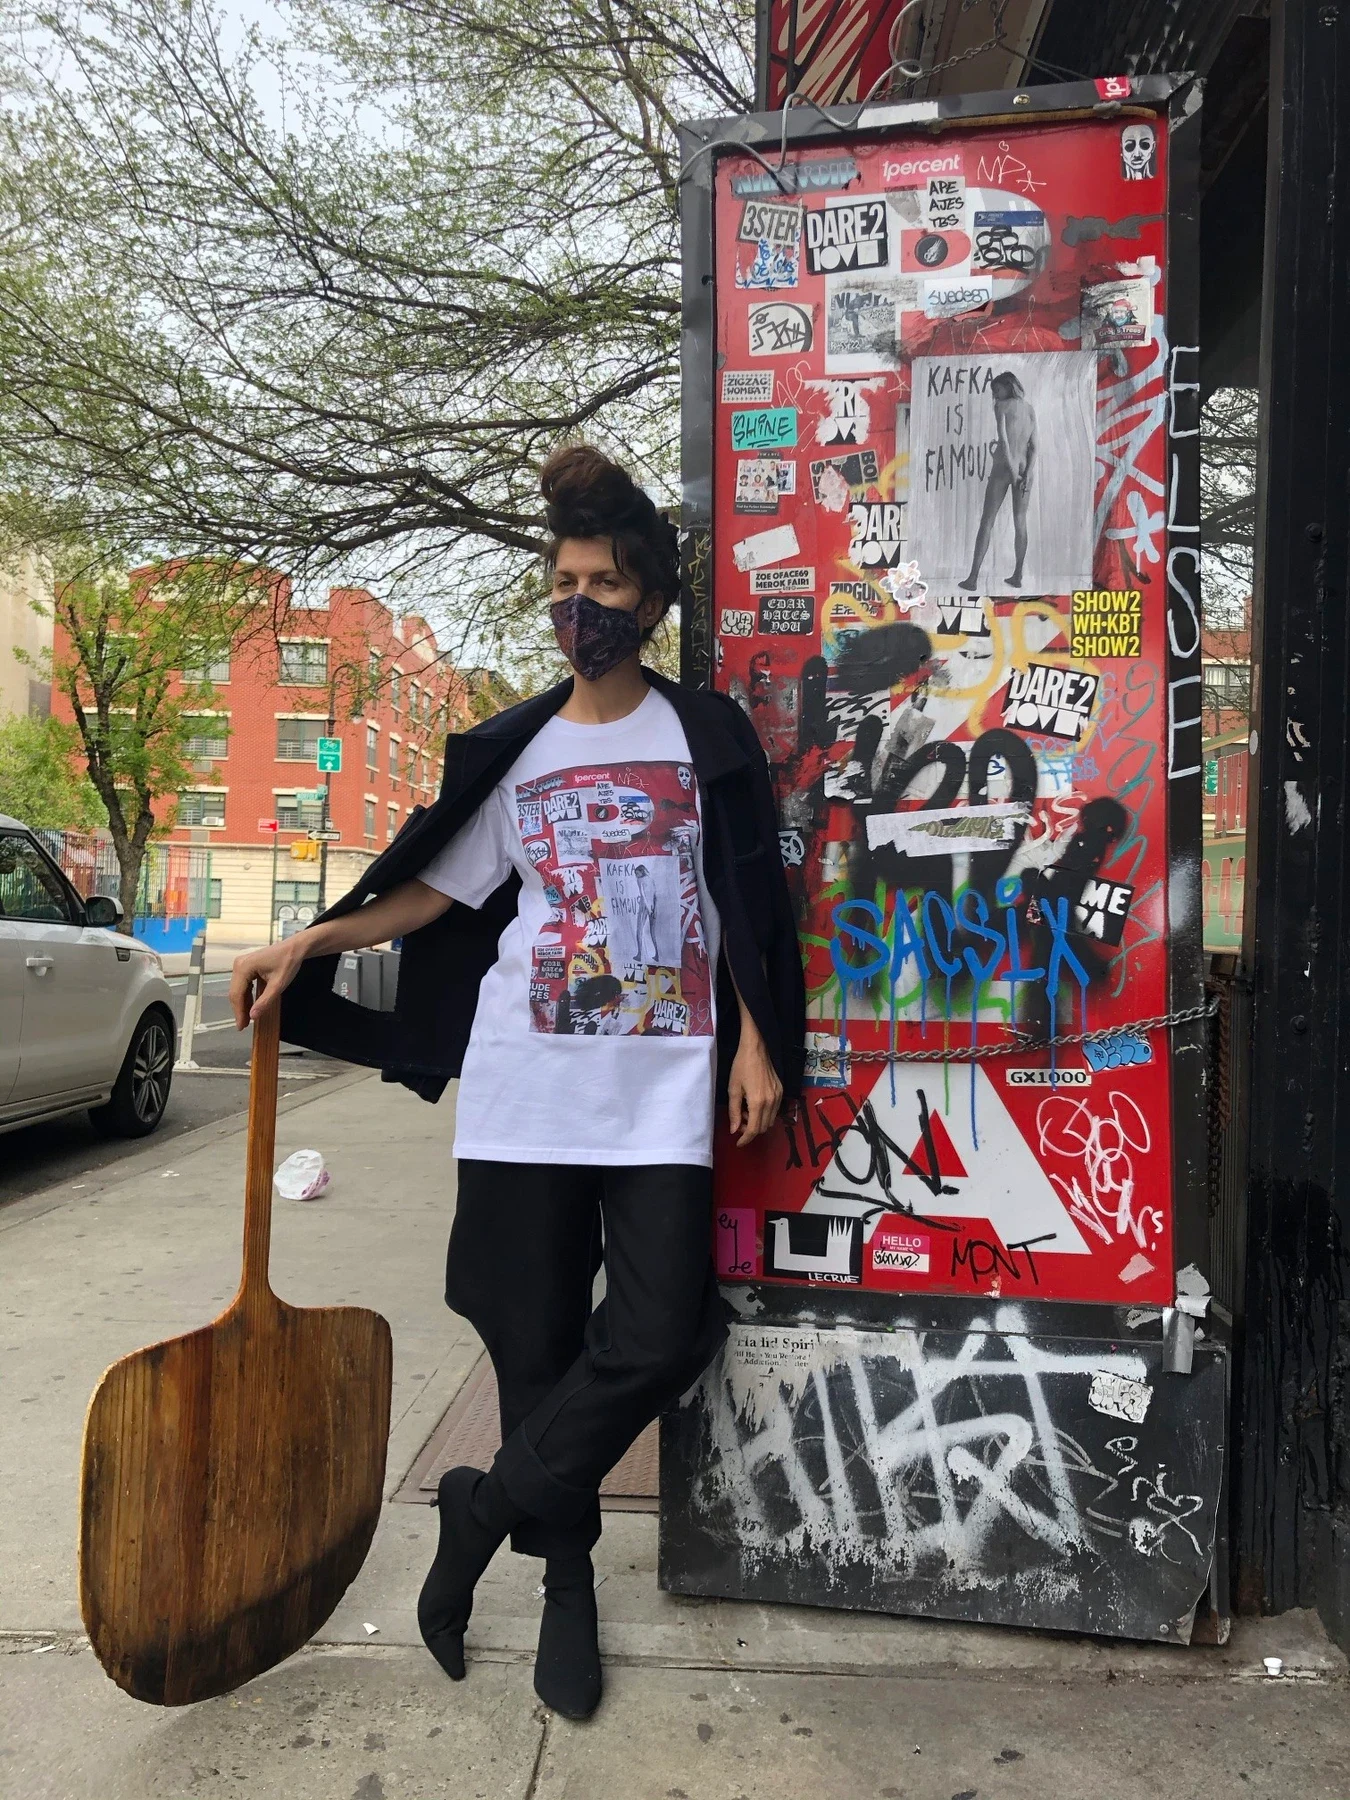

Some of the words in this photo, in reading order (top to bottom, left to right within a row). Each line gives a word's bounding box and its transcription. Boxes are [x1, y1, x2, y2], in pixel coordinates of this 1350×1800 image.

[883, 154, 961, 182] 1percent
[929, 181, 960, 196] APE
[929, 197, 965, 212] AJES
[806, 204, 885, 249] DARE2
[929, 214, 960, 228] TBS
[727, 377, 768, 387] ZIGZAG
[928, 366, 994, 397] KAFKA
[727, 387, 768, 396] WOMBAT
[946, 404, 964, 435] IS
[773, 570, 809, 579] OFACE69
[756, 580, 786, 588] MEROK
[788, 578, 810, 586] FAIR1
[767, 598, 806, 609] EDAR
[1073, 591, 1141, 612] SHOW2
[762, 610, 811, 622] HATES
[770, 621, 801, 634] YOU
[1072, 636, 1140, 657] SHOW2
[1008, 667, 1098, 714] DARE2
[574, 773, 610, 784] 1percent
[543, 792, 579, 816] DARE2
[607, 864, 636, 876] KAFKA
[616, 880, 624, 895] IS
[654, 1000, 686, 1023] DARE2
[1010, 1071, 1087, 1084] GX1000
[882, 1235, 922, 1247] HELLO
